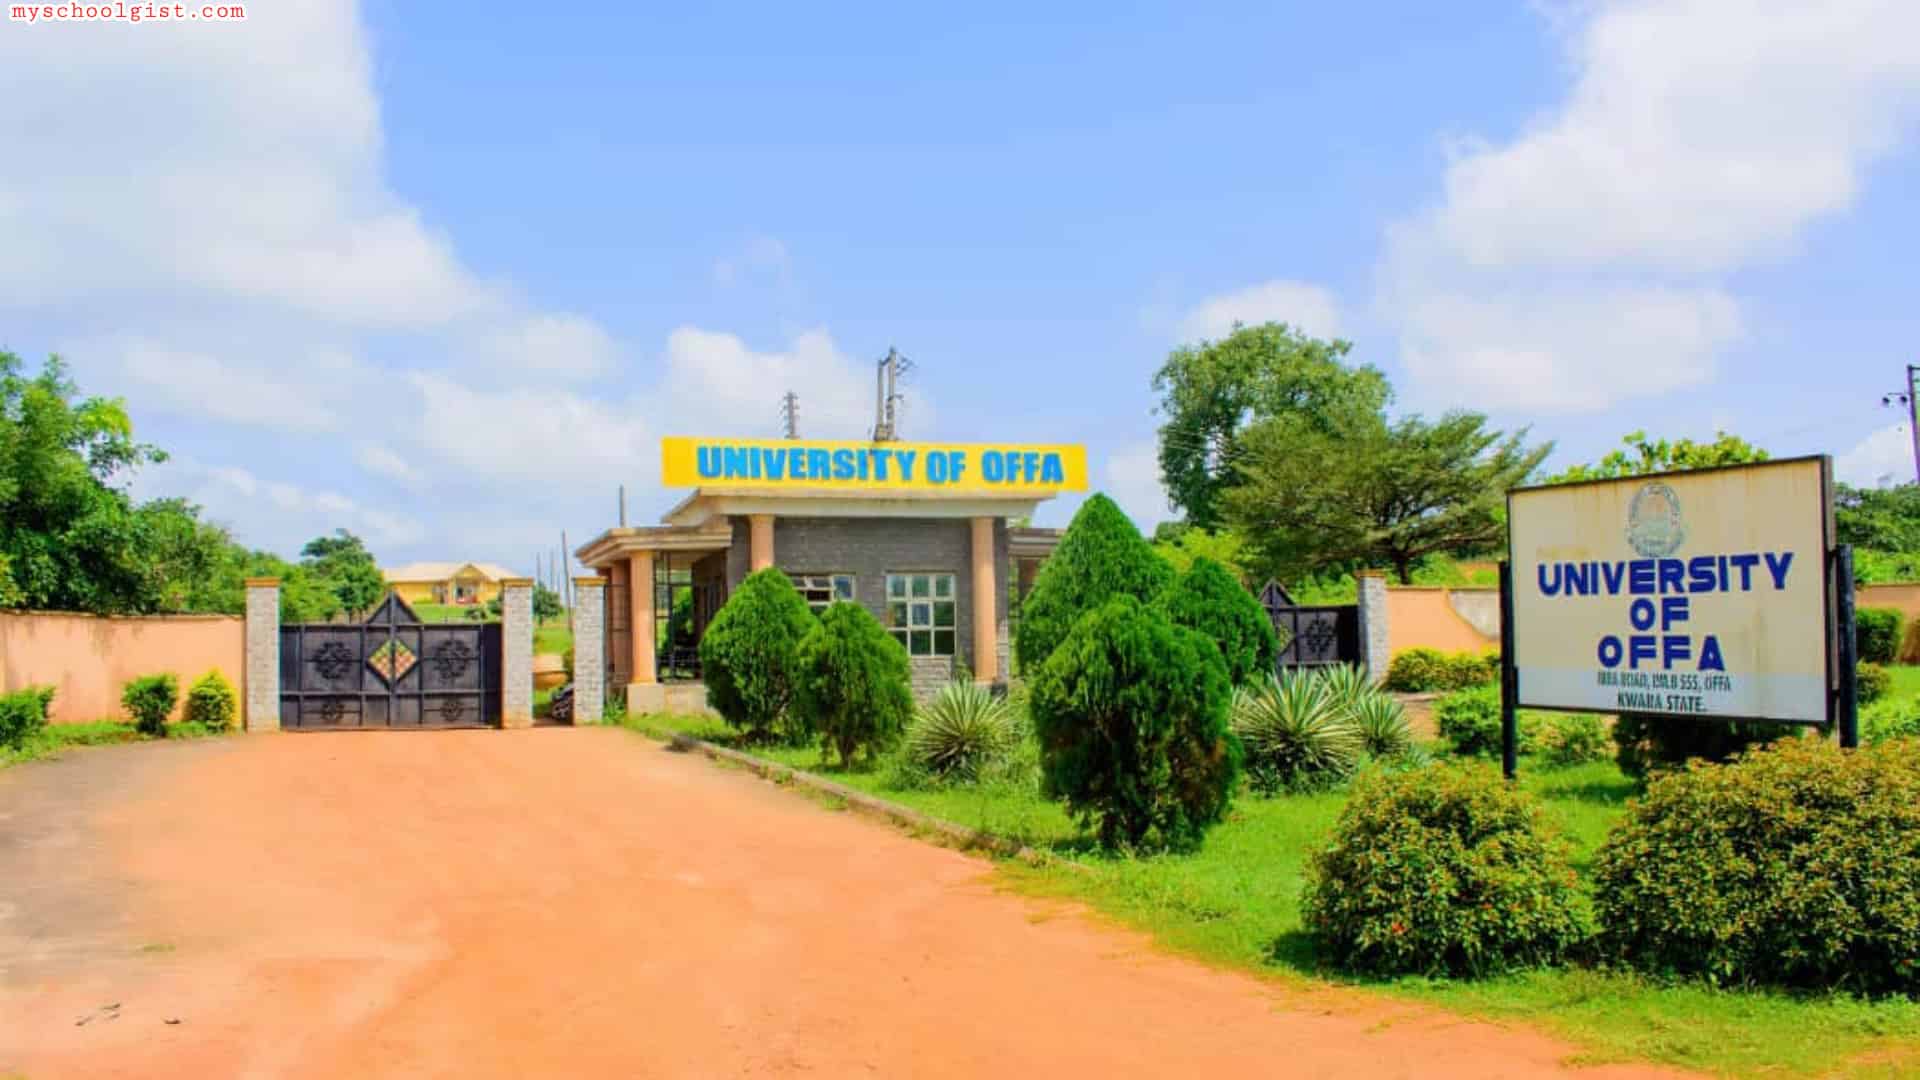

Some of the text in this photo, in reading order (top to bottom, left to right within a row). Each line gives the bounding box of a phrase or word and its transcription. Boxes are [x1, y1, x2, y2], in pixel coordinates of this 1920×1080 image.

[697, 446, 1064, 483] UNIVERSITY OF OFFA
[1537, 552, 1794, 596] UNIVERSITY
[1629, 598, 1689, 632] OF
[1597, 635, 1725, 671] OFFA
[1617, 691, 1663, 710] KWARA
[1704, 676, 1731, 692] OFFA
